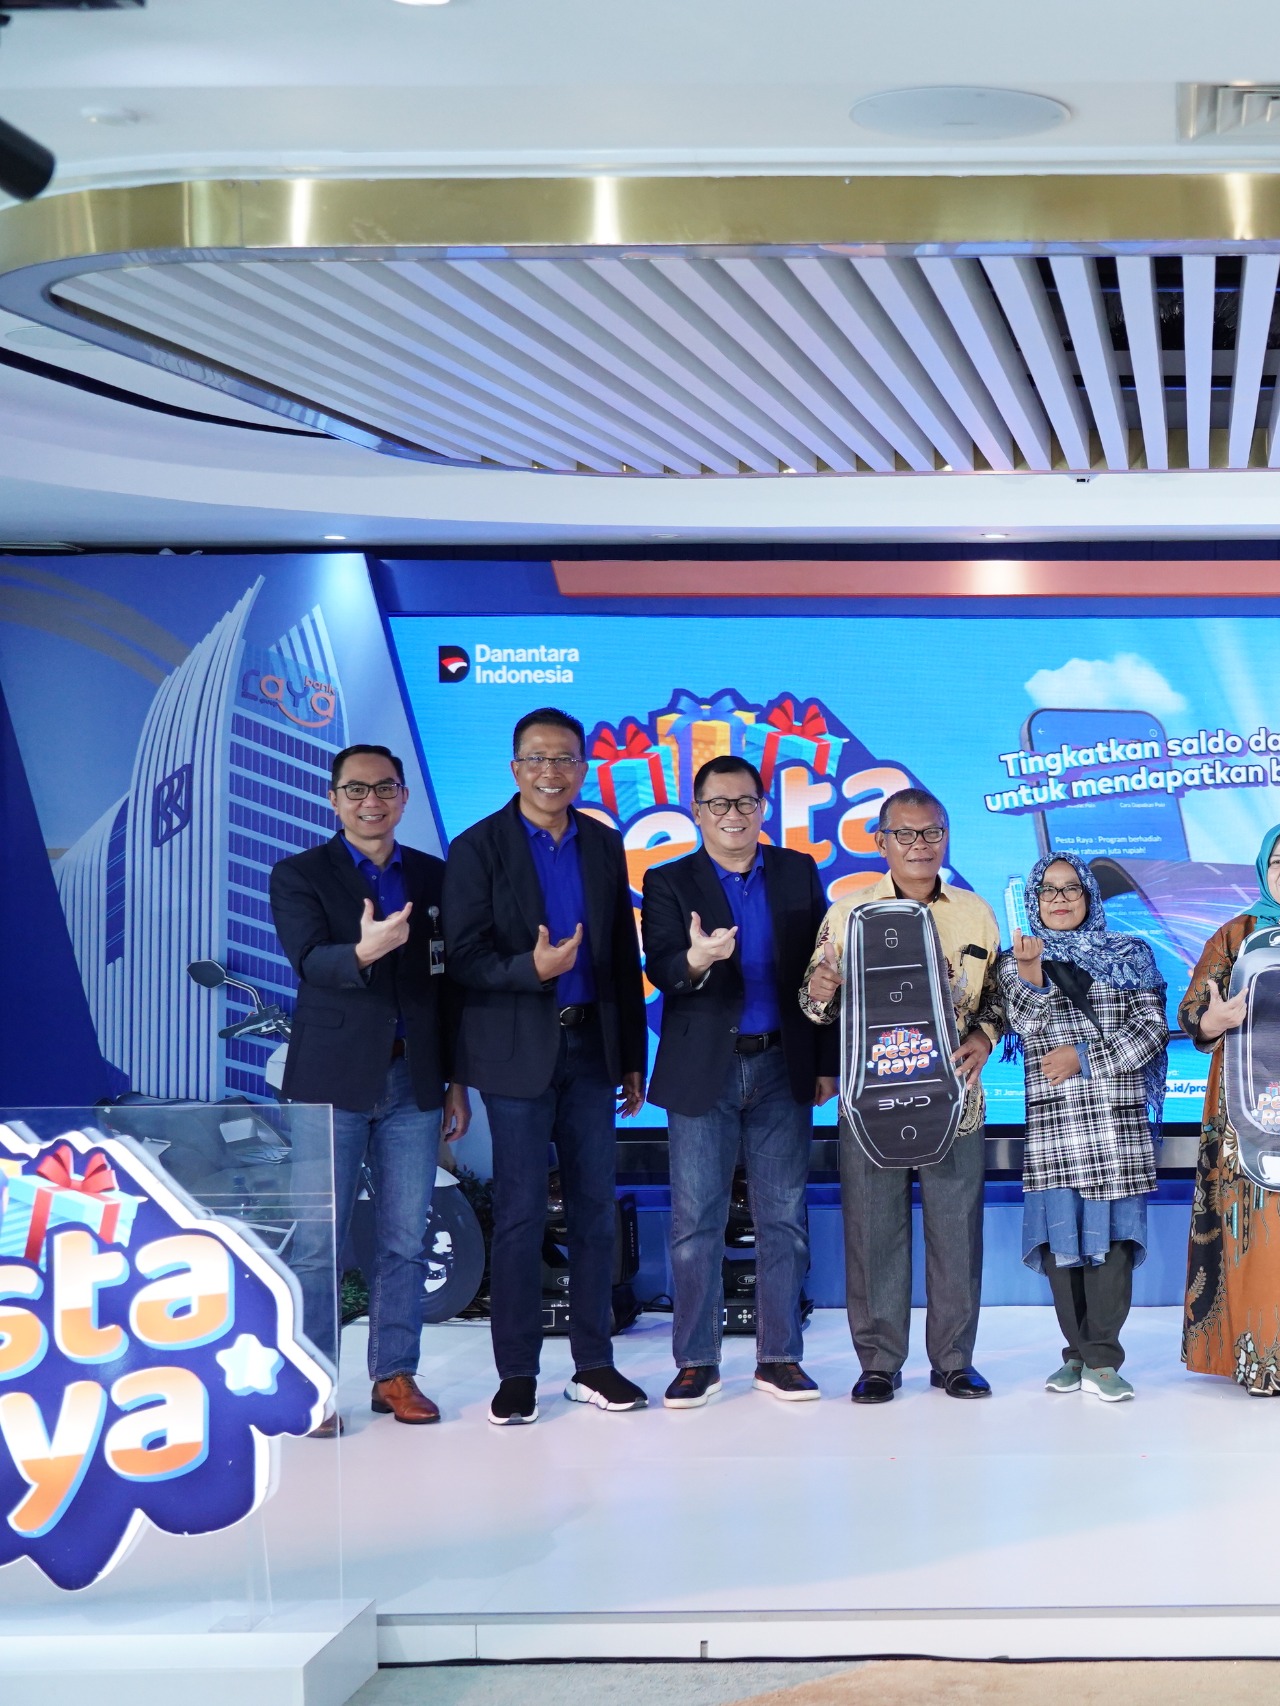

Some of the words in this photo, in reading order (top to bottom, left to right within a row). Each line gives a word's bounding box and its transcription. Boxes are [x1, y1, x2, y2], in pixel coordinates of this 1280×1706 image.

[475, 643, 580, 663] Danantara
[475, 664, 574, 684] Indonesia
[304, 676, 336, 696] bank
[999, 738, 1161, 778] Tingkatkan
[1167, 729, 1243, 757] saldo
[984, 777, 1070, 812] untuk
[1072, 759, 1264, 799] mendapatkan
[1098, 836, 1127, 844] Program
[1128, 835, 1162, 843] berhadiah
[1107, 847, 1121, 855] juta
[872, 1038, 933, 1062] Pesta
[877, 1053, 930, 1076] Raya
[879, 1095, 931, 1111] BYD
